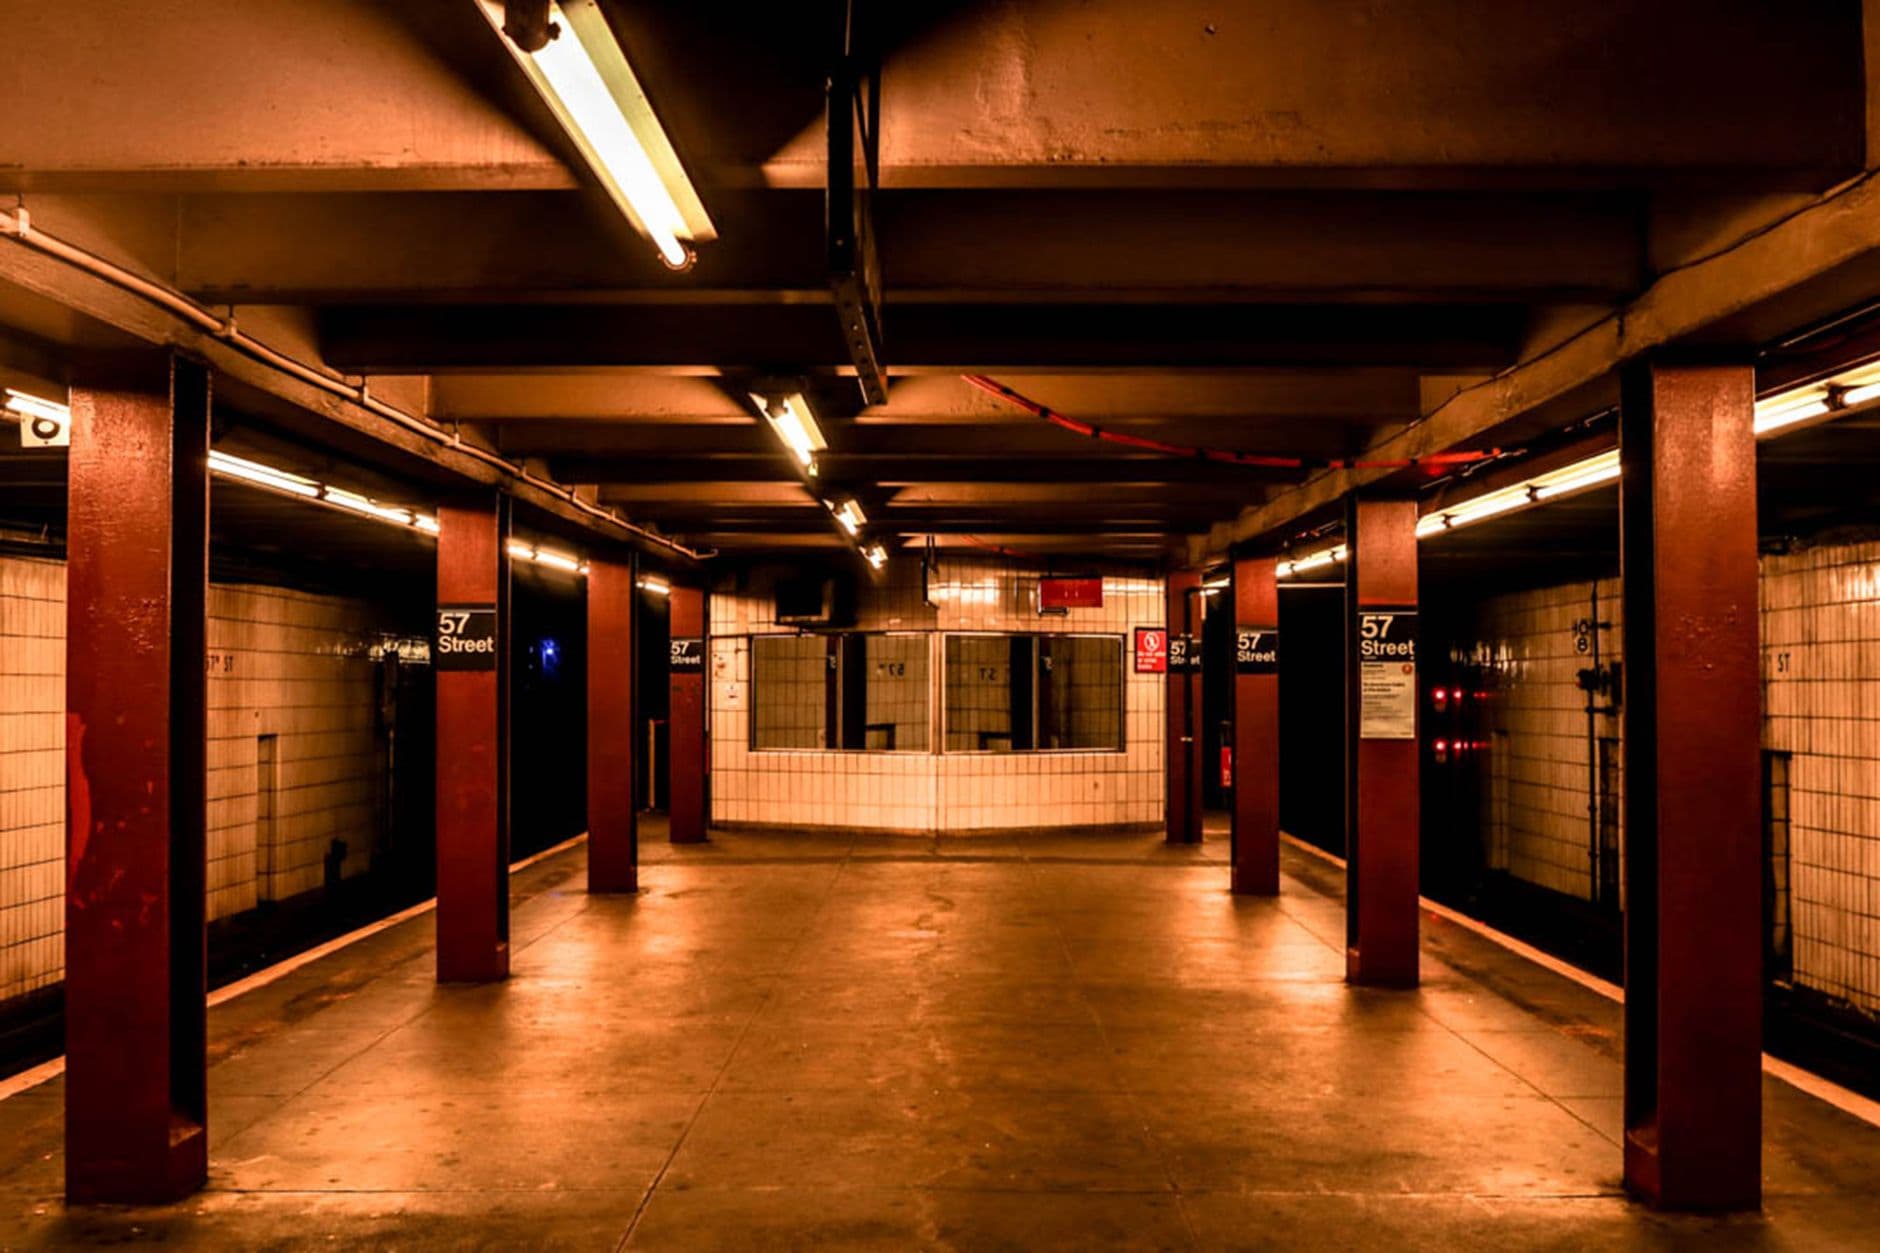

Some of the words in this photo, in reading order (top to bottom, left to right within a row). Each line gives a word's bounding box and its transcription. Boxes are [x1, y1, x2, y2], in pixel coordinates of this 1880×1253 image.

[439, 612, 470, 634] 57
[1361, 615, 1394, 638] 57
[438, 635, 494, 653] Street
[670, 641, 690, 655] 57
[1170, 640, 1186, 655] 57
[1237, 632, 1261, 650] 57
[1361, 639, 1415, 656] Street
[1577, 637, 1588, 652] 8
[1169, 655, 1200, 665] Stret
[1237, 650, 1276, 662] Street
[1778, 653, 1791, 672] ST
